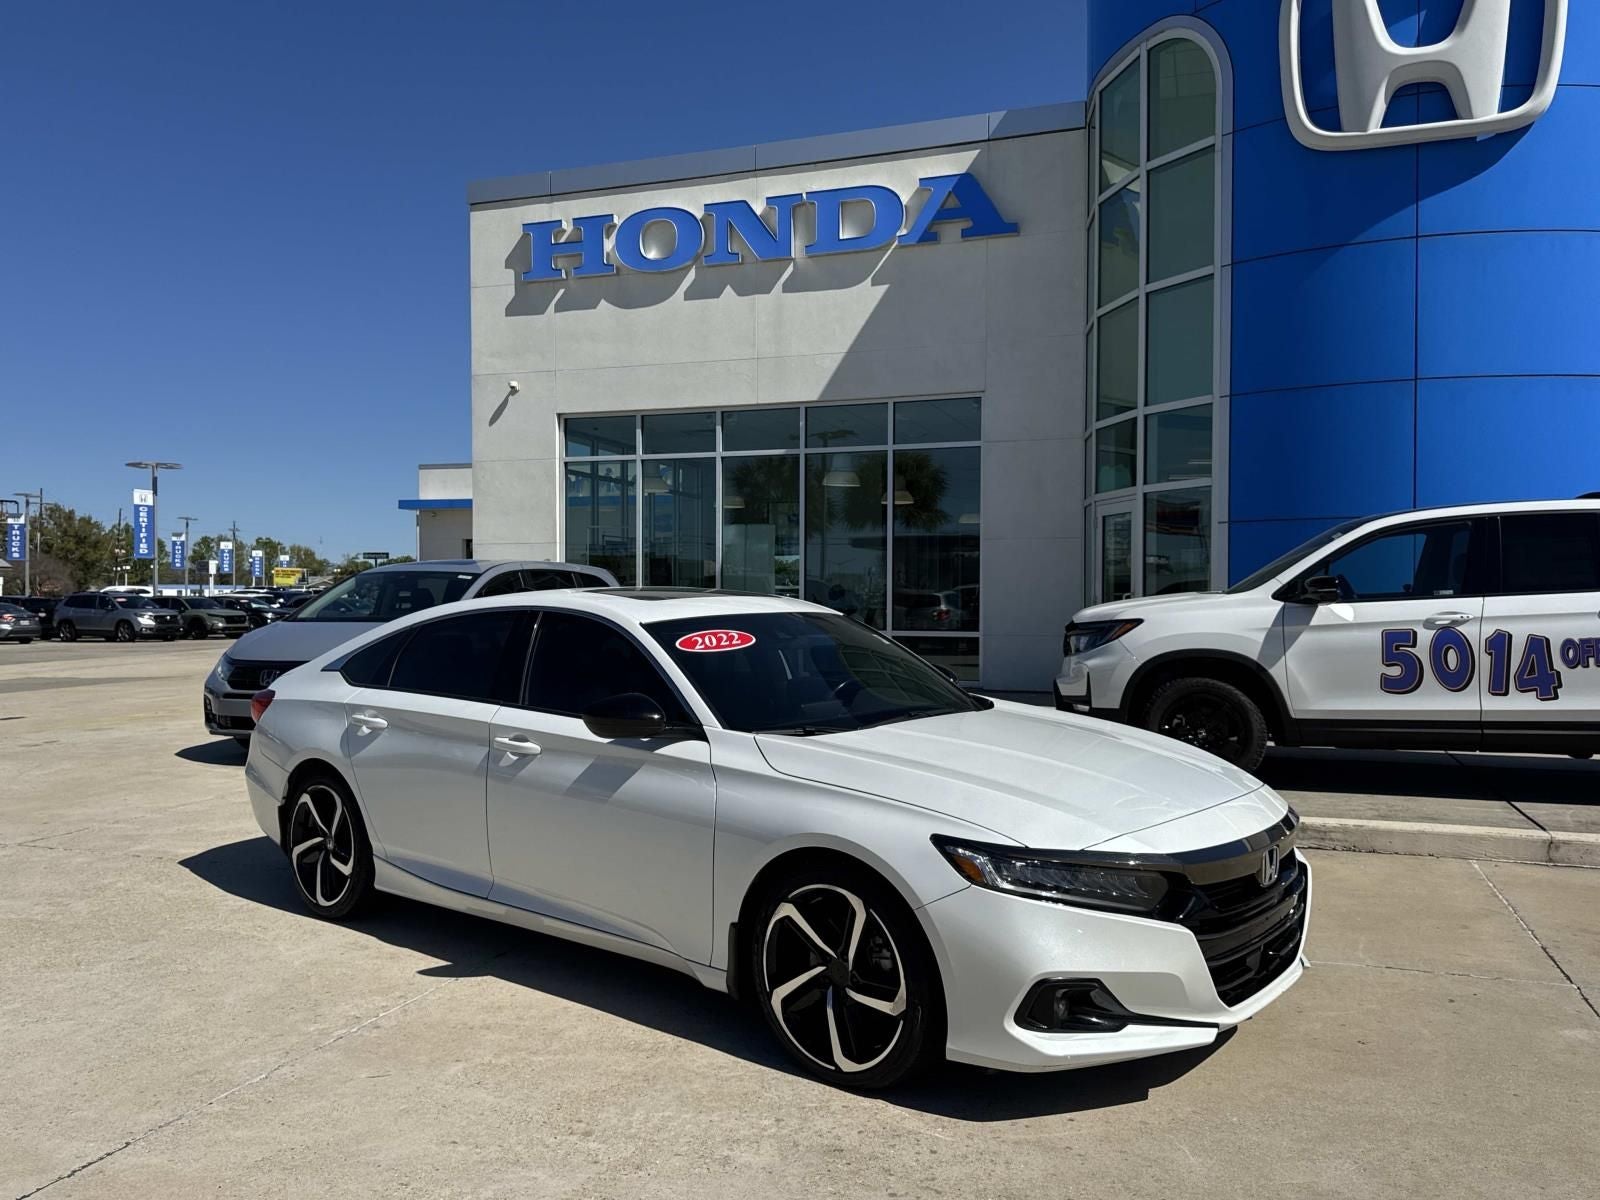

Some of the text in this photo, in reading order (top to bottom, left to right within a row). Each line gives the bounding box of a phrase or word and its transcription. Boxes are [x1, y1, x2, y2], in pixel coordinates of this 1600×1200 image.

[521, 172, 1020, 281] HONDA
[11, 524, 20, 558] TRUCKS
[138, 506, 149, 554] CERTIFIED
[174, 541, 182, 568] TRUCKS
[691, 632, 741, 650] 2022
[1380, 626, 1600, 701] 5014 OF
